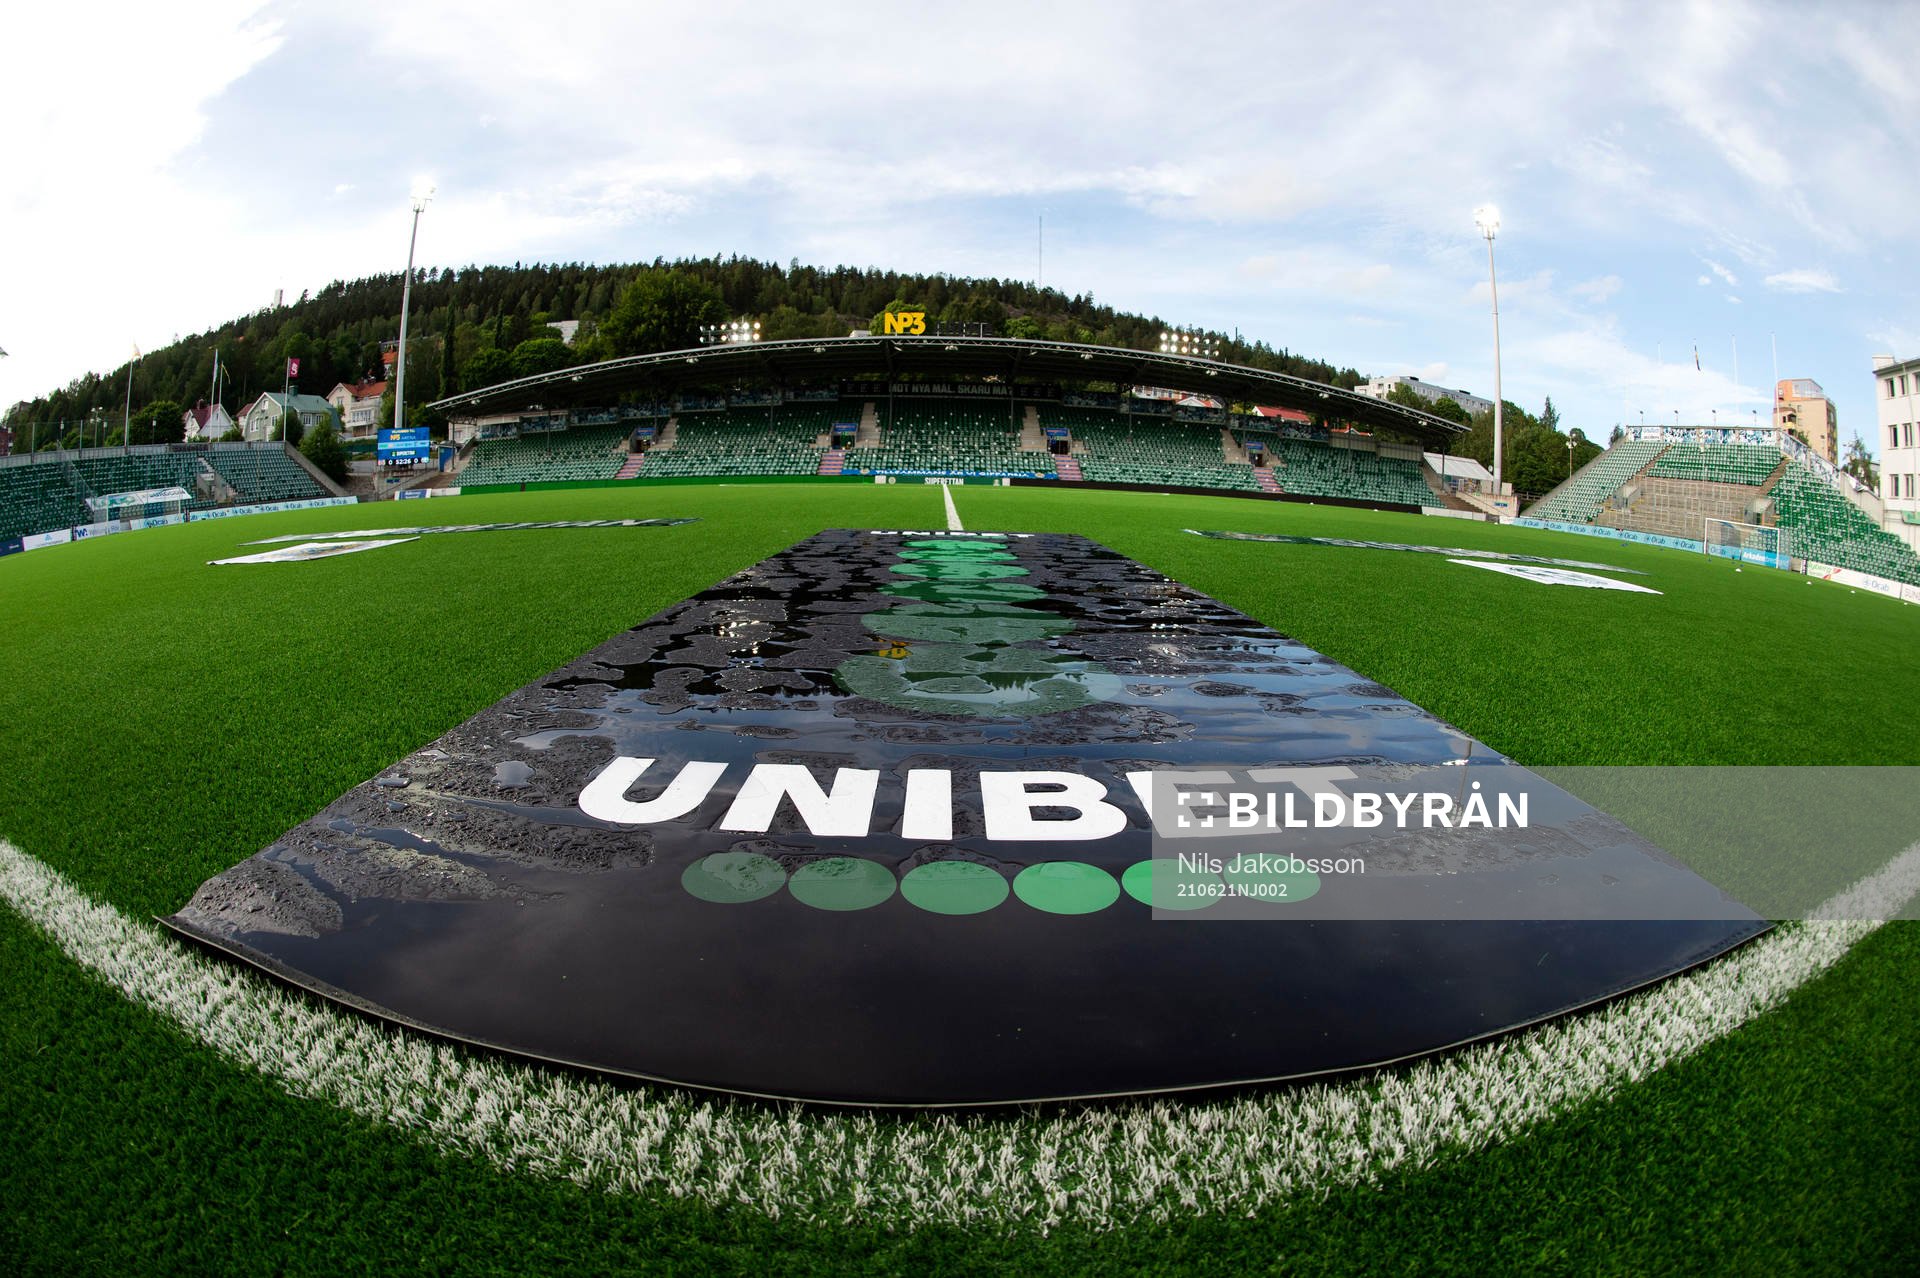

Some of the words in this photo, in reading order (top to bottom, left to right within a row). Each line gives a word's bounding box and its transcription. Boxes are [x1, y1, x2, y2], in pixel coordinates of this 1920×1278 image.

[884, 312, 926, 335] NP3
[912, 383, 931, 393] NYA
[924, 477, 964, 486] SUPERETTAN
[1871, 578, 1889, 592] Ocab
[577, 757, 1375, 842] UNIBET
